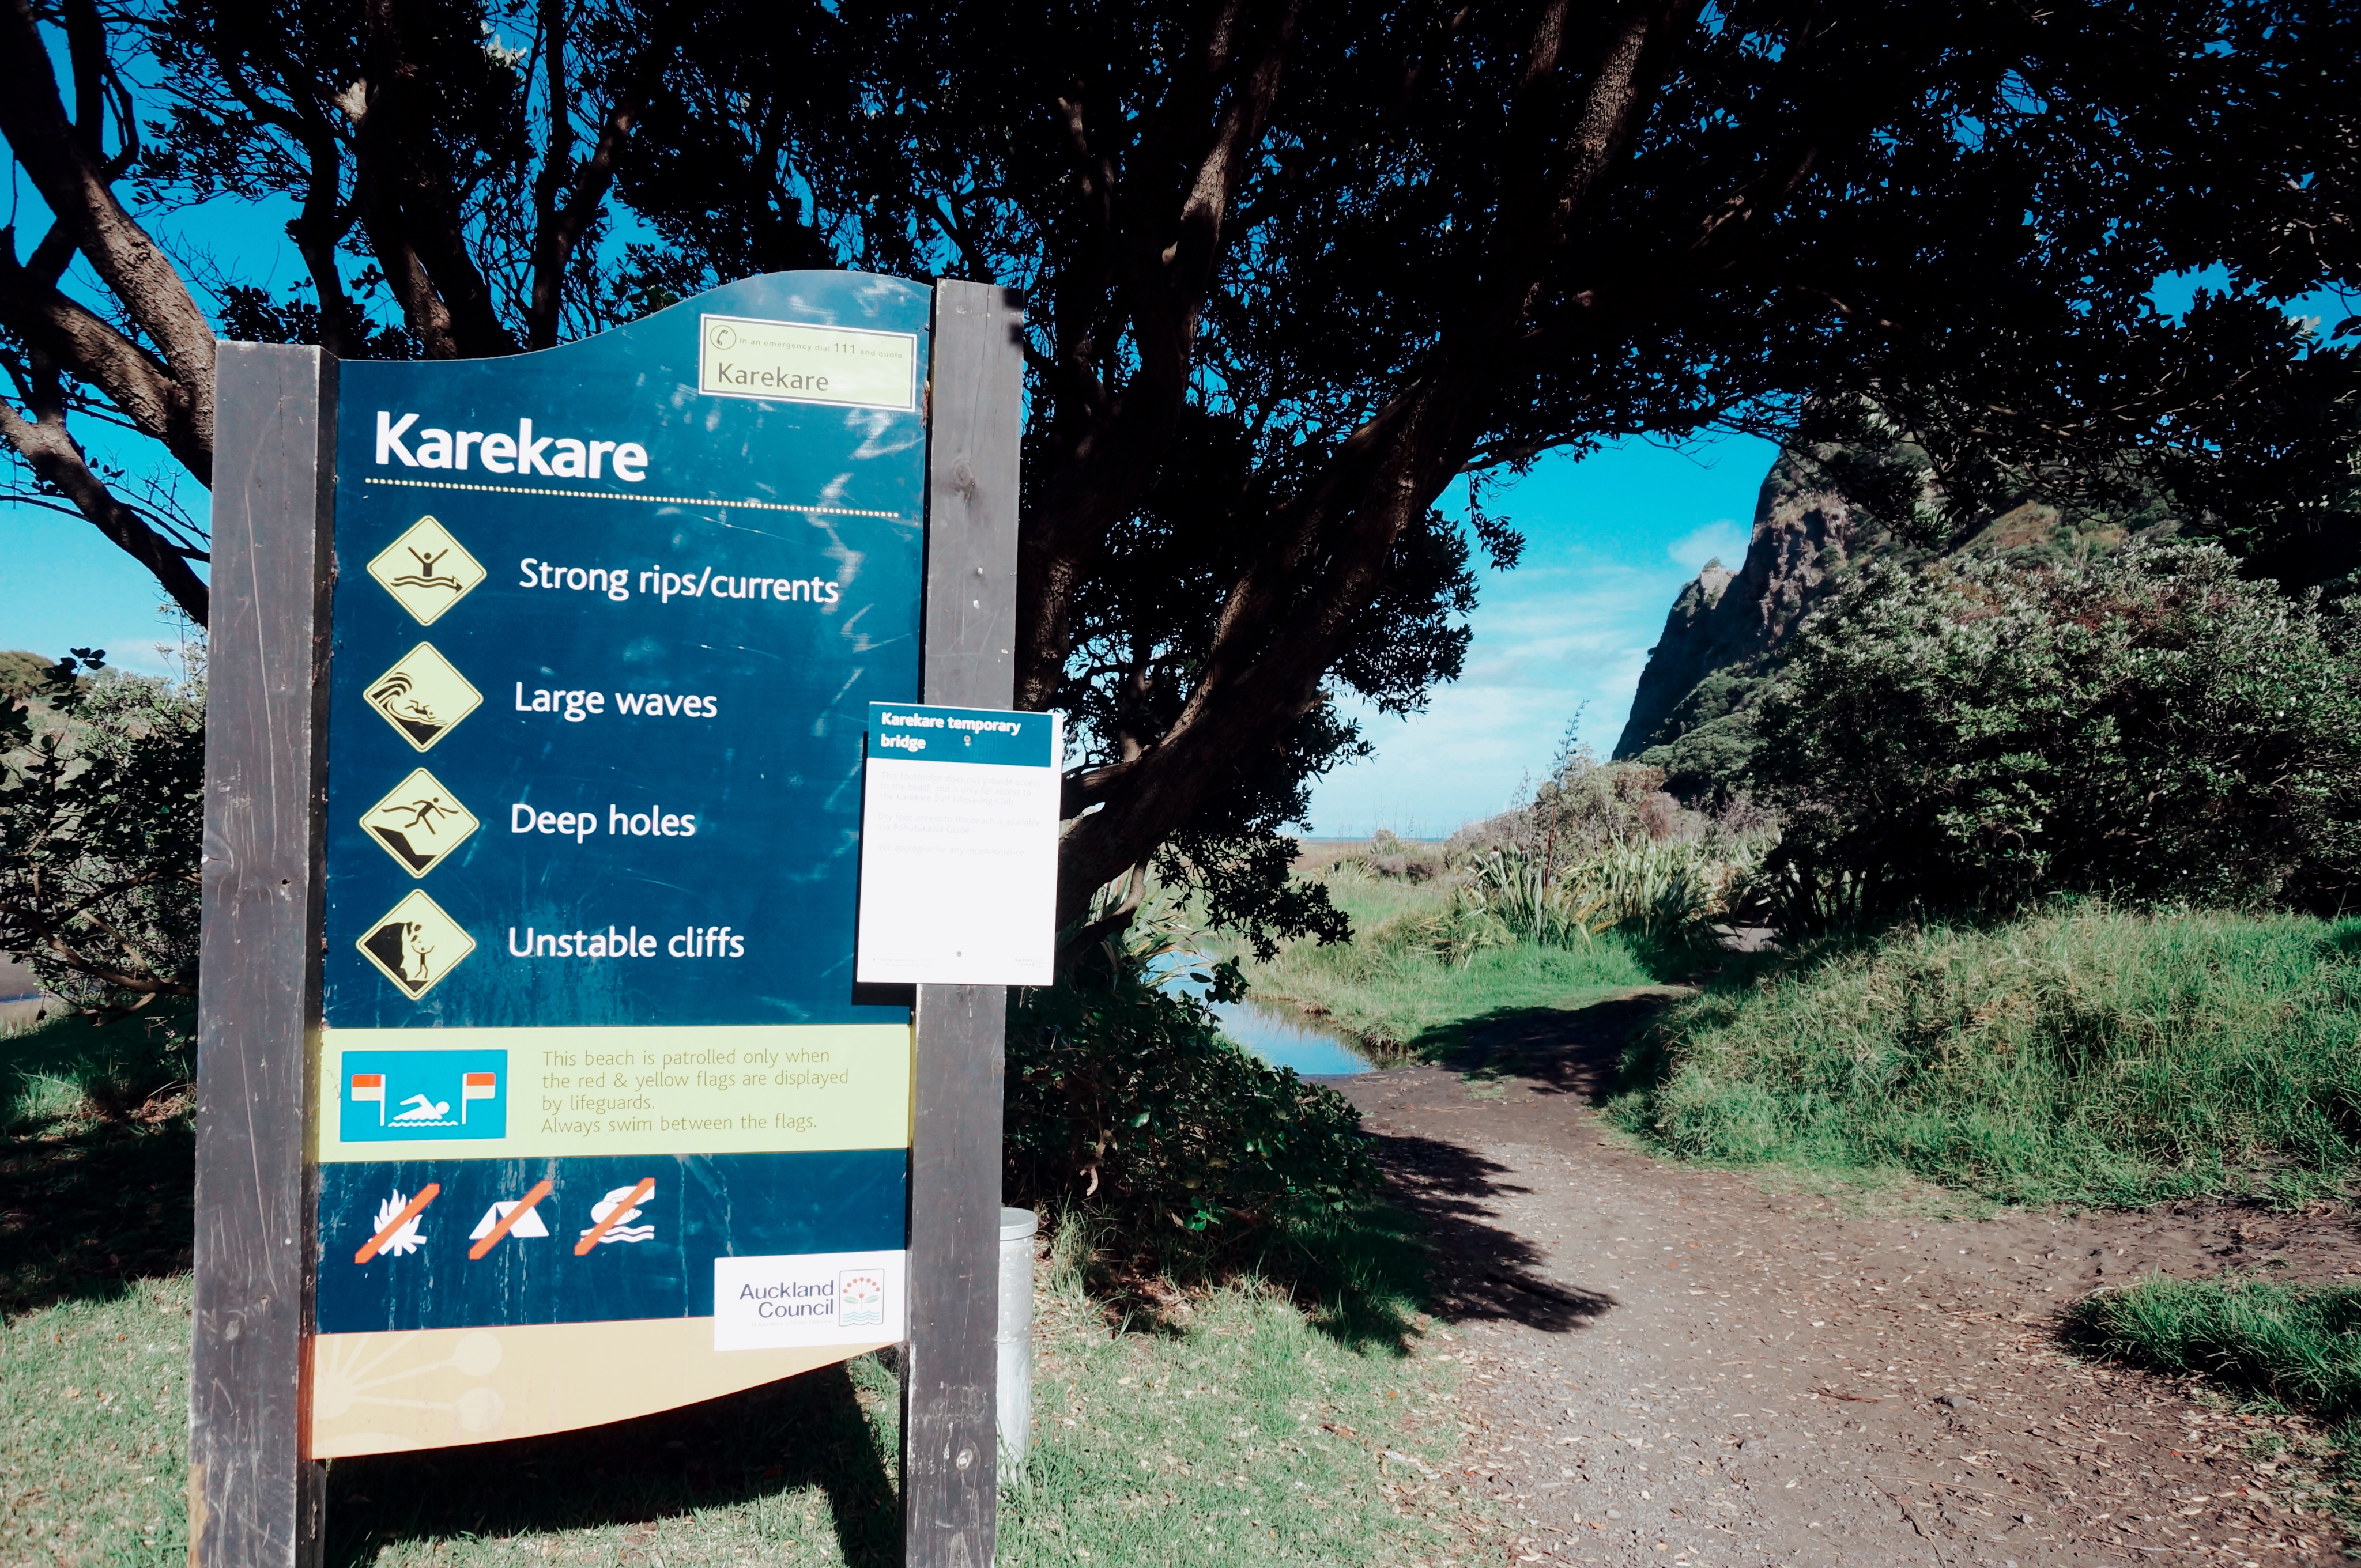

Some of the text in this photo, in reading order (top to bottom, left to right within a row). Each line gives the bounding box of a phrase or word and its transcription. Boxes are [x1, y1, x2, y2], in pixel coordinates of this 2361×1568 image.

[764, 342, 811, 351] emergency
[835, 343, 854, 353] 111
[718, 362, 829, 392] Karekare
[374, 411, 648, 483] Karekare
[520, 558, 839, 604] Strong rips/currents
[516, 682, 716, 721] Large waves
[882, 712, 1021, 735] Karekare temporary
[881, 734, 926, 752] bridge
[512, 804, 695, 843] Deep holes
[510, 926, 744, 958] Unstable cliffs
[543, 1048, 829, 1070] This beach is patrolled only when
[543, 1069, 848, 1091] the red & yellow flags are displayed
[543, 1094, 654, 1114] by lifeguards.
[541, 1113, 816, 1136] Always swim between the flags.
[740, 1280, 833, 1300] Auckland
[758, 1299, 833, 1318] Council
